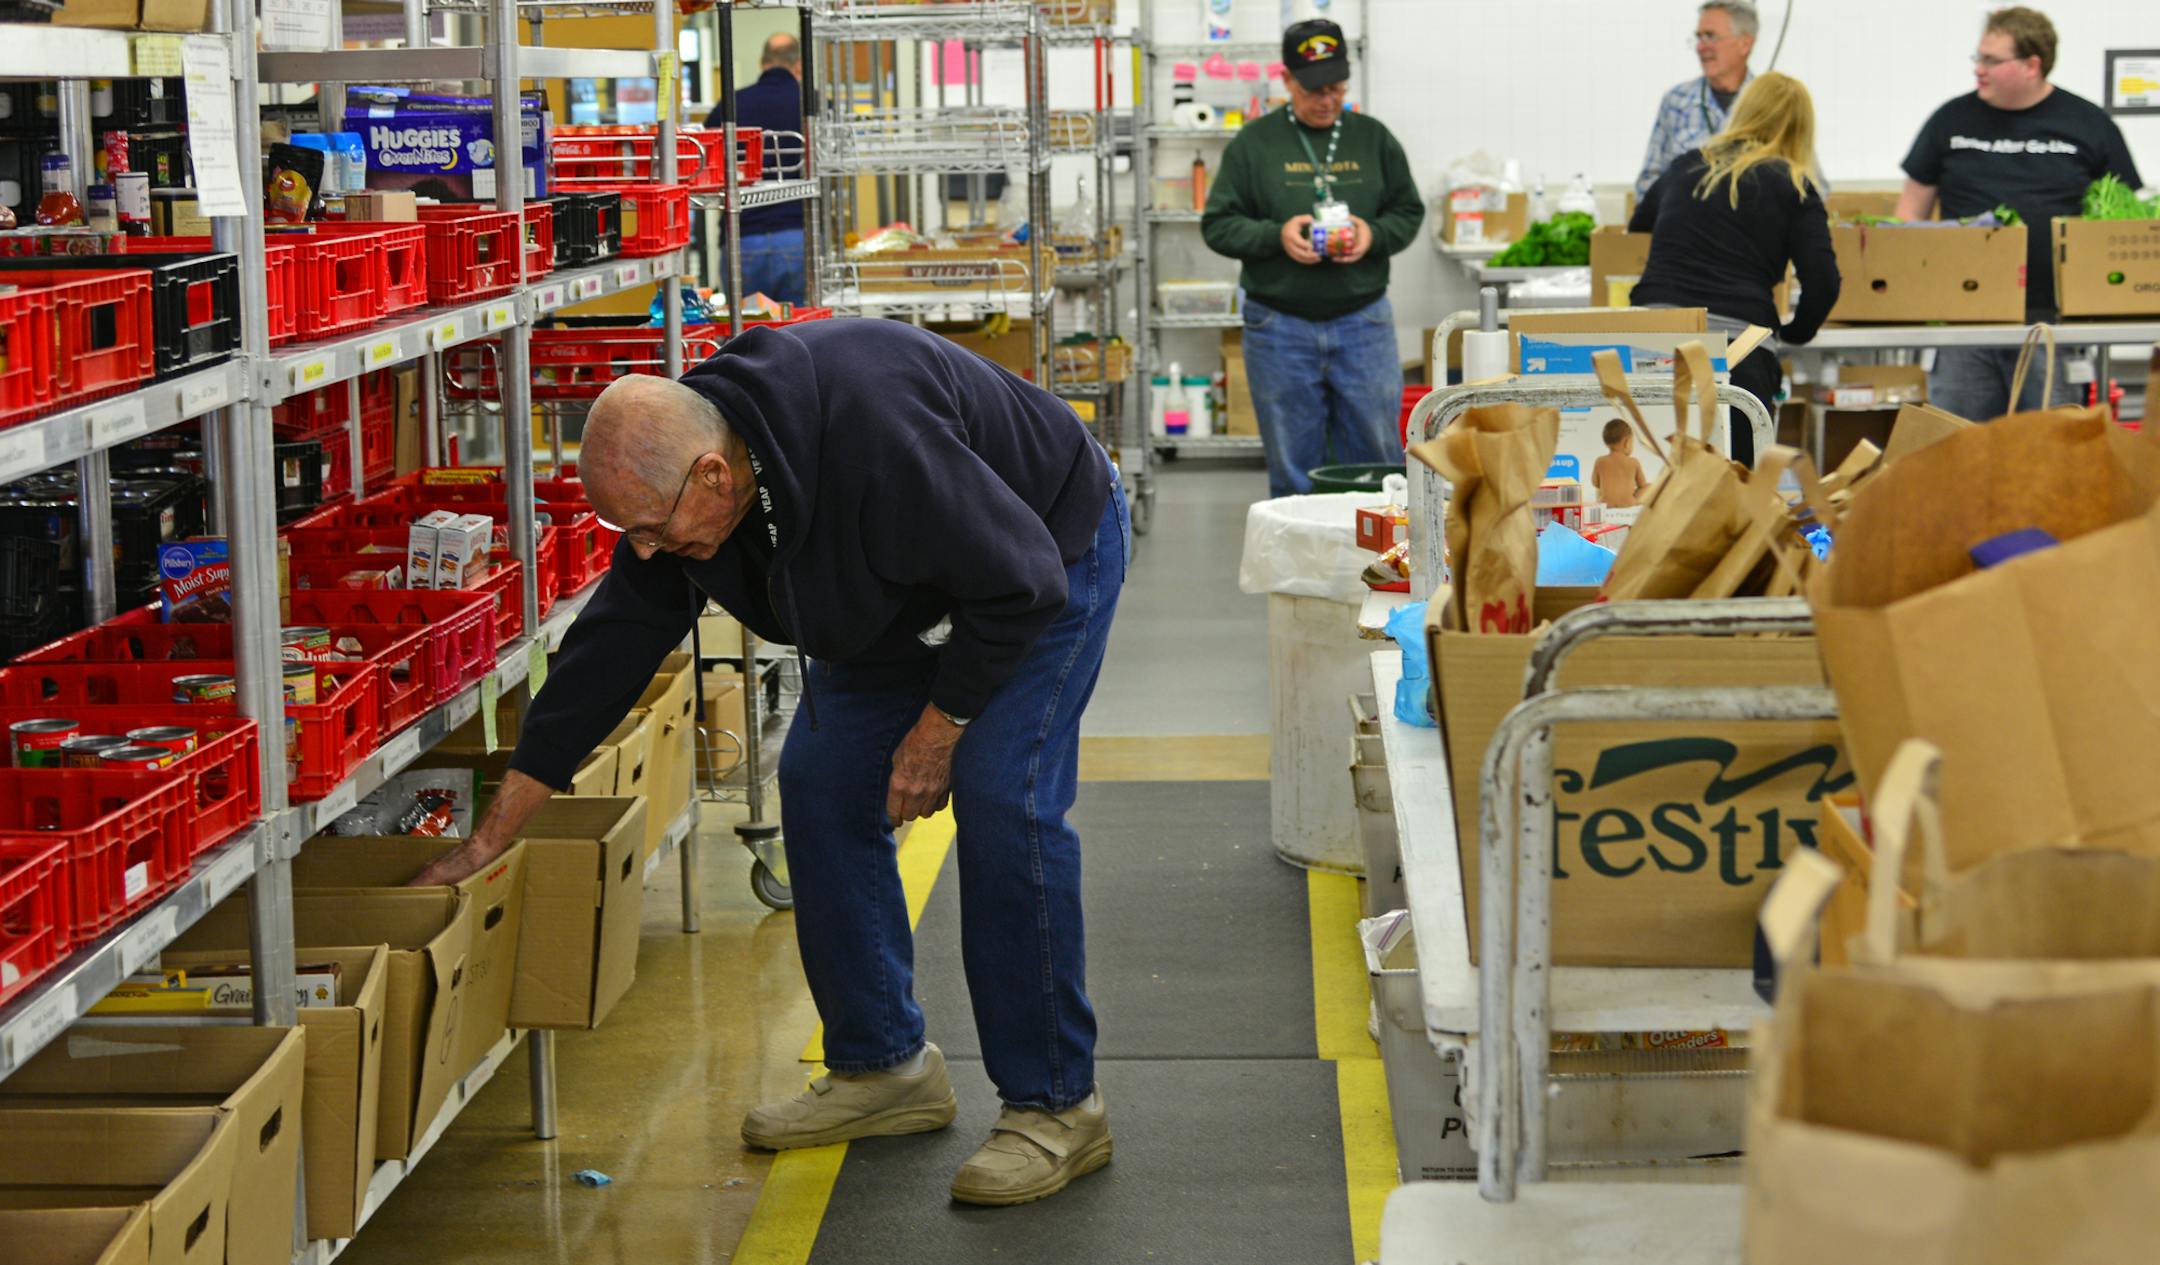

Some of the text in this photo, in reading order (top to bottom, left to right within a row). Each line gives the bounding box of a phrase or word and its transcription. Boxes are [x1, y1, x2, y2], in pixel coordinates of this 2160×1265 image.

[759, 486, 772, 513] VEAP
[768, 523, 777, 547] EAP
[173, 572, 204, 599] Moist
